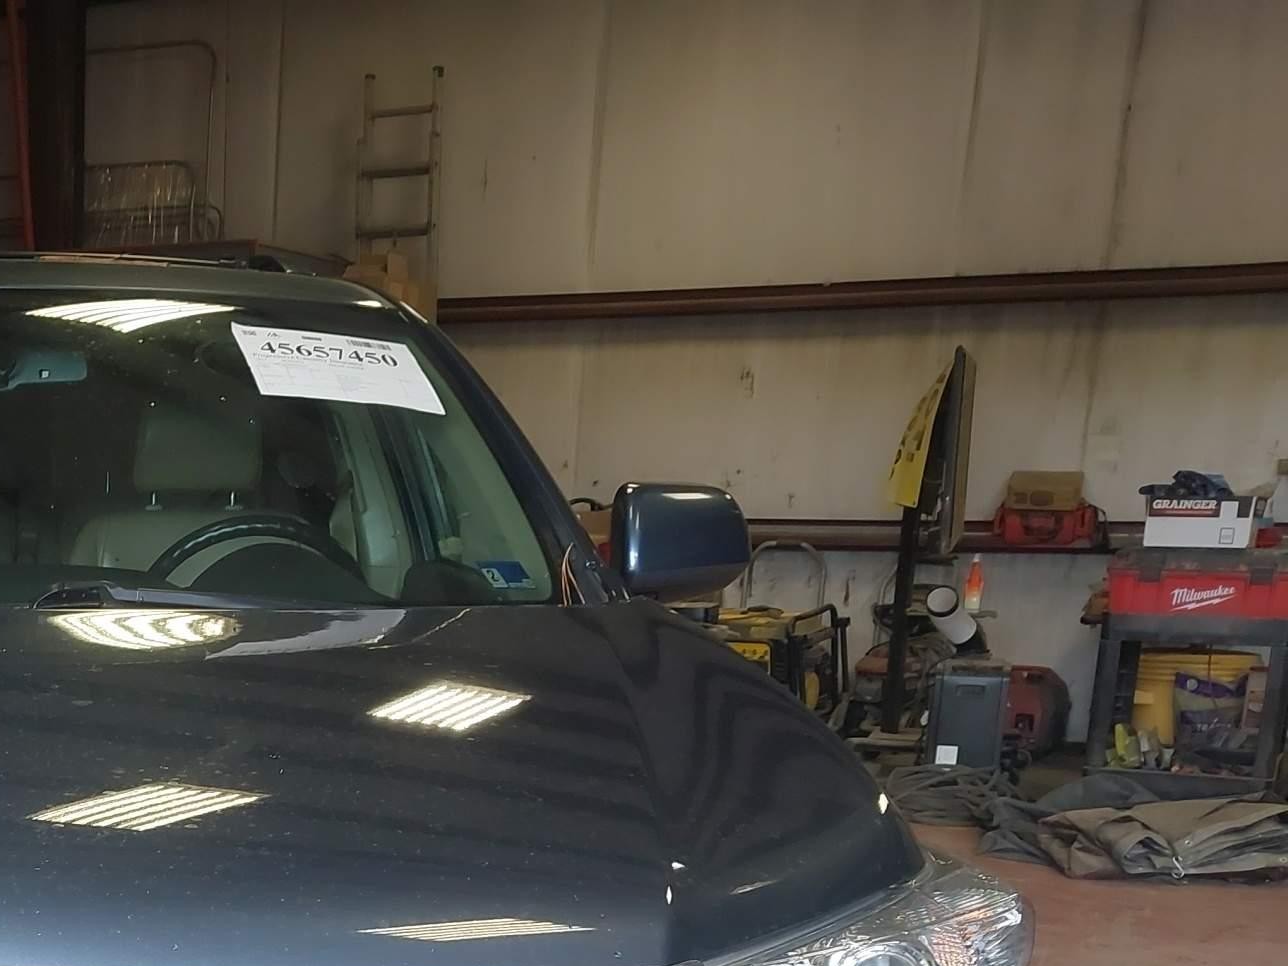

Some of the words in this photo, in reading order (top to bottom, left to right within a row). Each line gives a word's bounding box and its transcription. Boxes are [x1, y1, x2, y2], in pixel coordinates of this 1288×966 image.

[261, 341, 399, 368] 45657450
[1152, 499, 1218, 510] GRAINGER
[1170, 585, 1236, 606] Milwaukee
